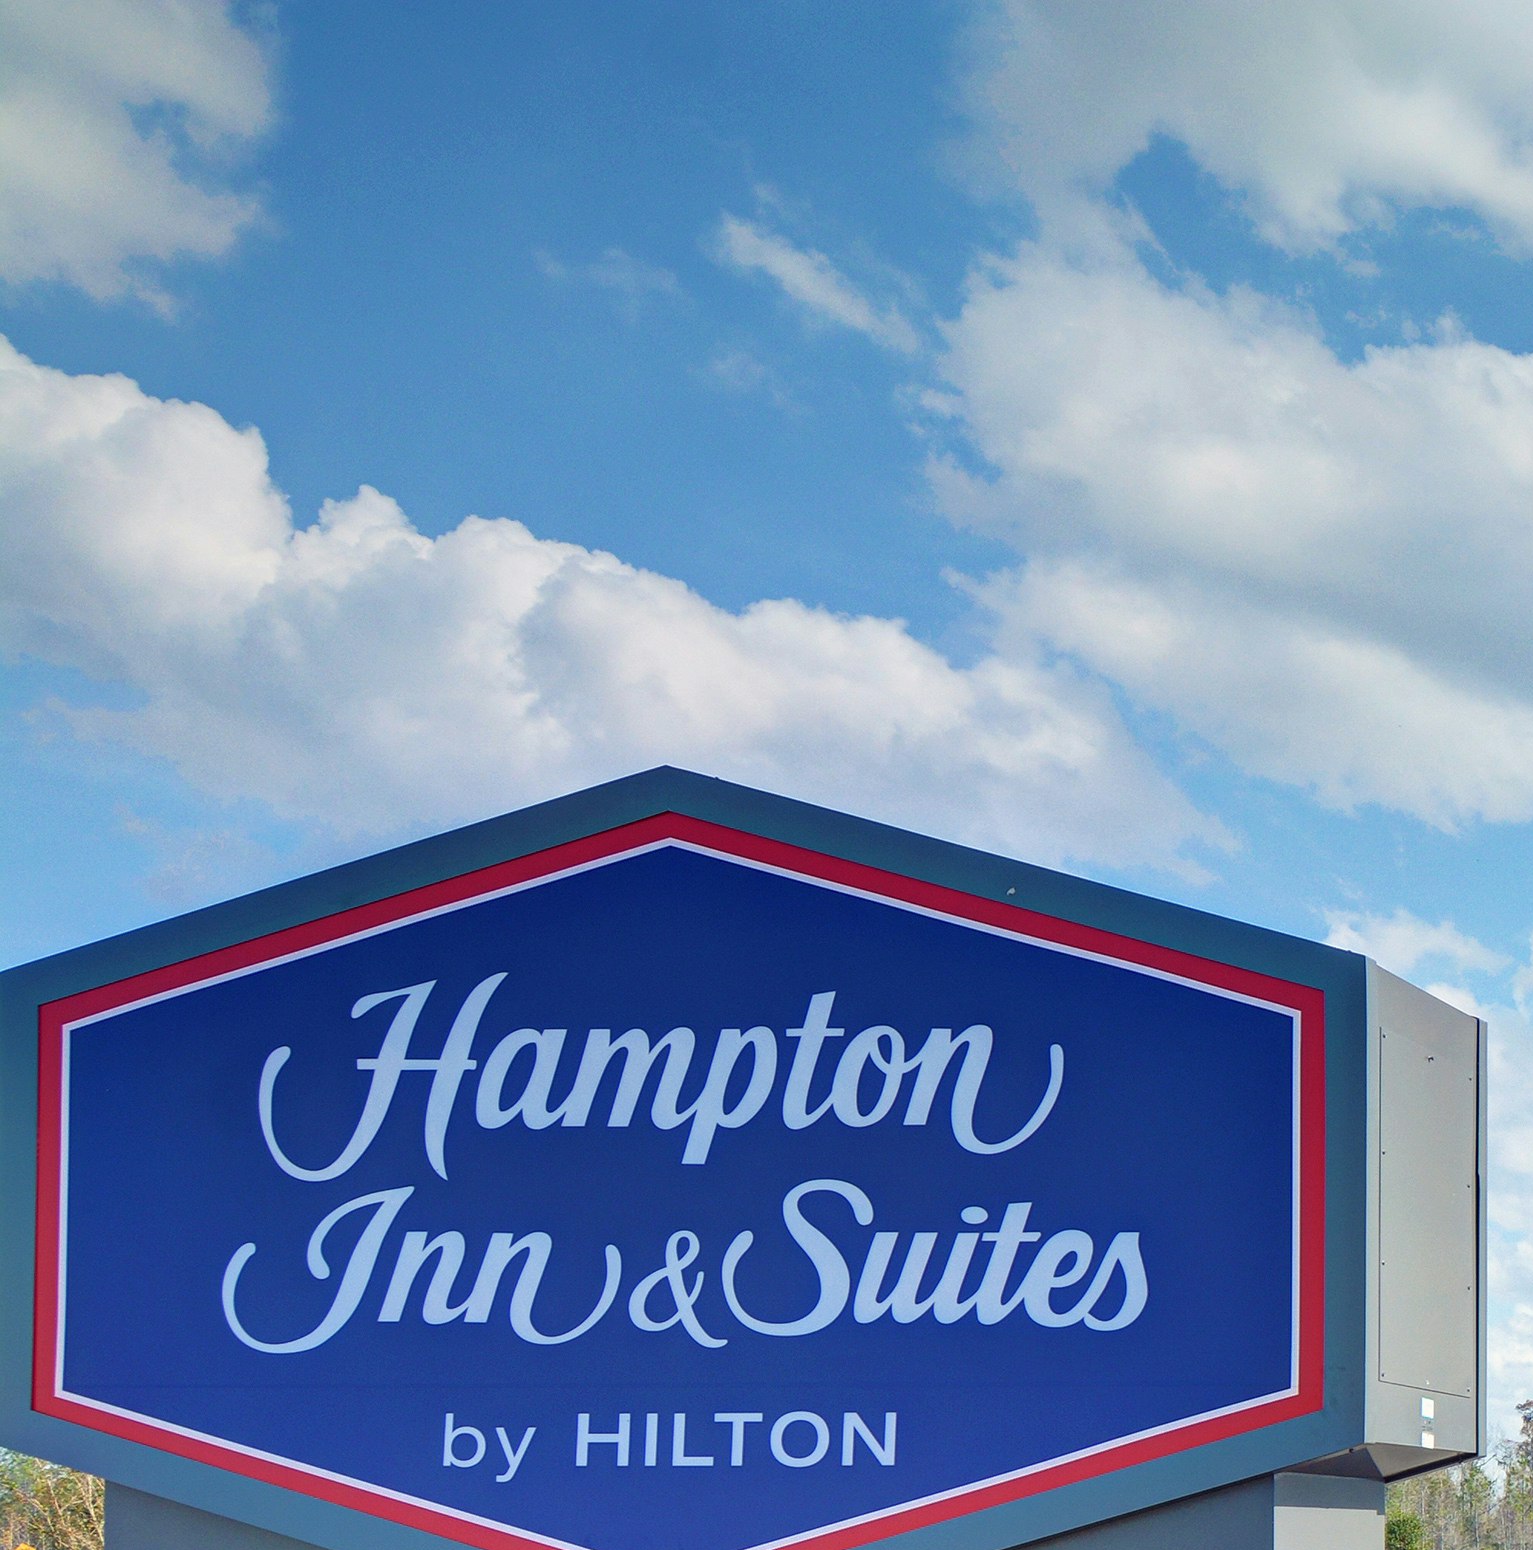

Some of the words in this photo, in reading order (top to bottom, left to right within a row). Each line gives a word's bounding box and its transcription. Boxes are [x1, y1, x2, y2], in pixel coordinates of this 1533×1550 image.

[258, 972, 1064, 1182] Hampton
[221, 1186, 622, 1354] Inn
[628, 1230, 728, 1348] &
[721, 1179, 1148, 1337] Suites
[442, 1412, 537, 1483] by
[575, 1411, 897, 1468] HILTON
